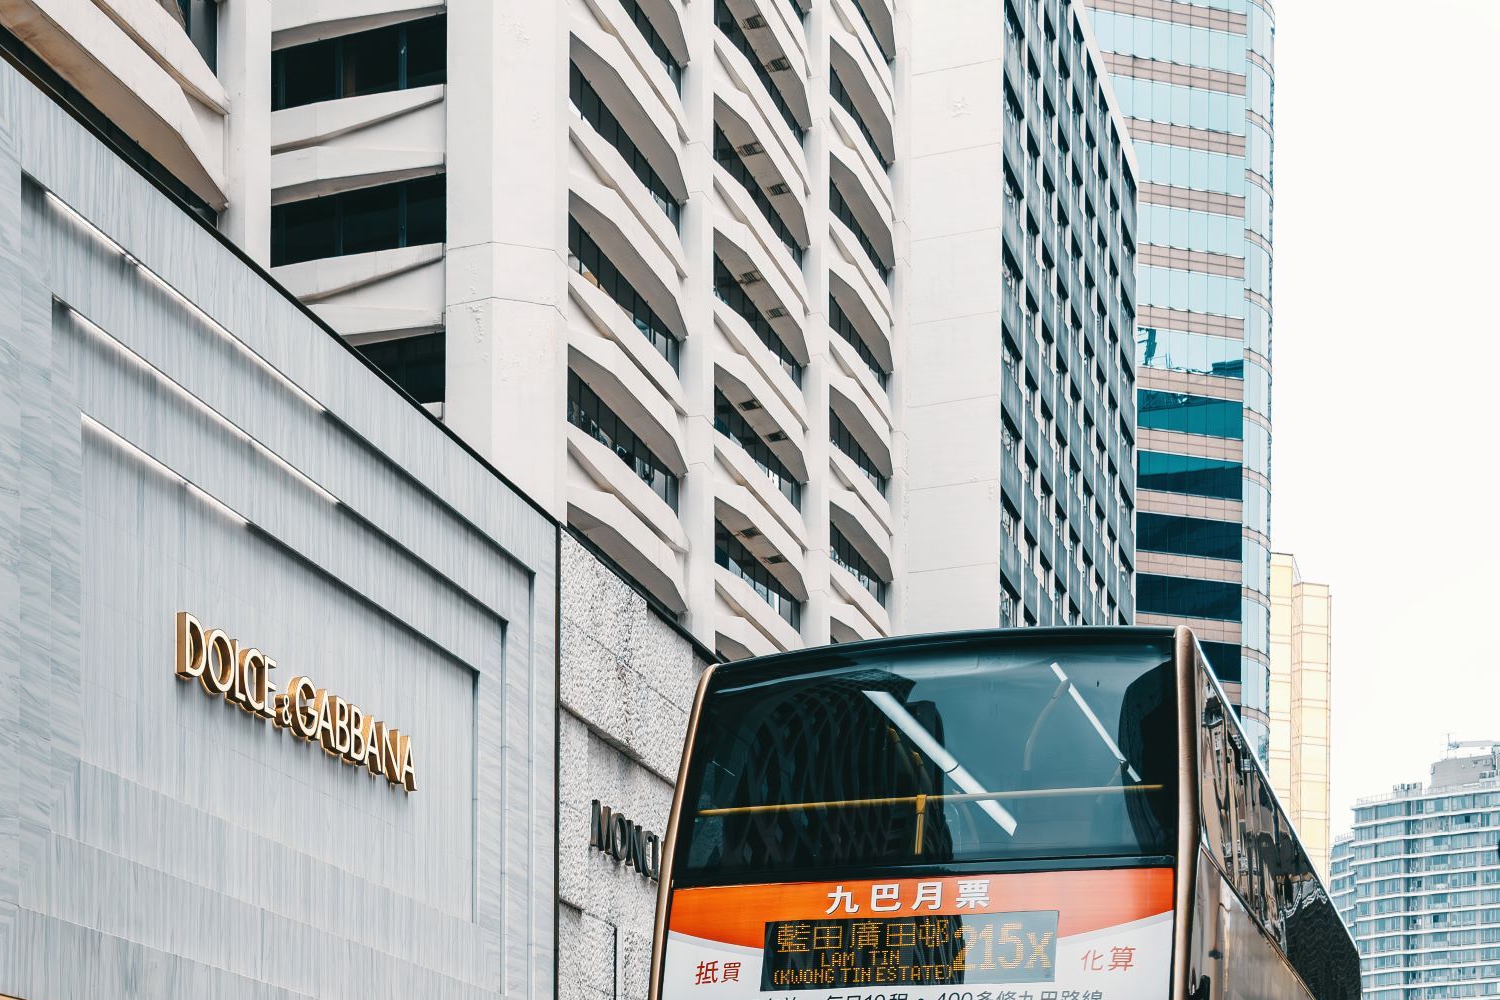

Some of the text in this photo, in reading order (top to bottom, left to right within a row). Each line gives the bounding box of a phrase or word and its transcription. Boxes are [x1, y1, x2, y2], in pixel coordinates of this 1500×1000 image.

[175, 611, 418, 792] DOLCE & GABBANA
[825, 879, 991, 915] 九巴月票
[777, 918, 949, 953] 藍田廣田邨
[821, 949, 900, 967] LAM TIN
[1081, 945, 1136, 972] 化算
[695, 960, 741, 985] 抵買
[774, 964, 952, 985] (KWONG TIN ESTATE)
